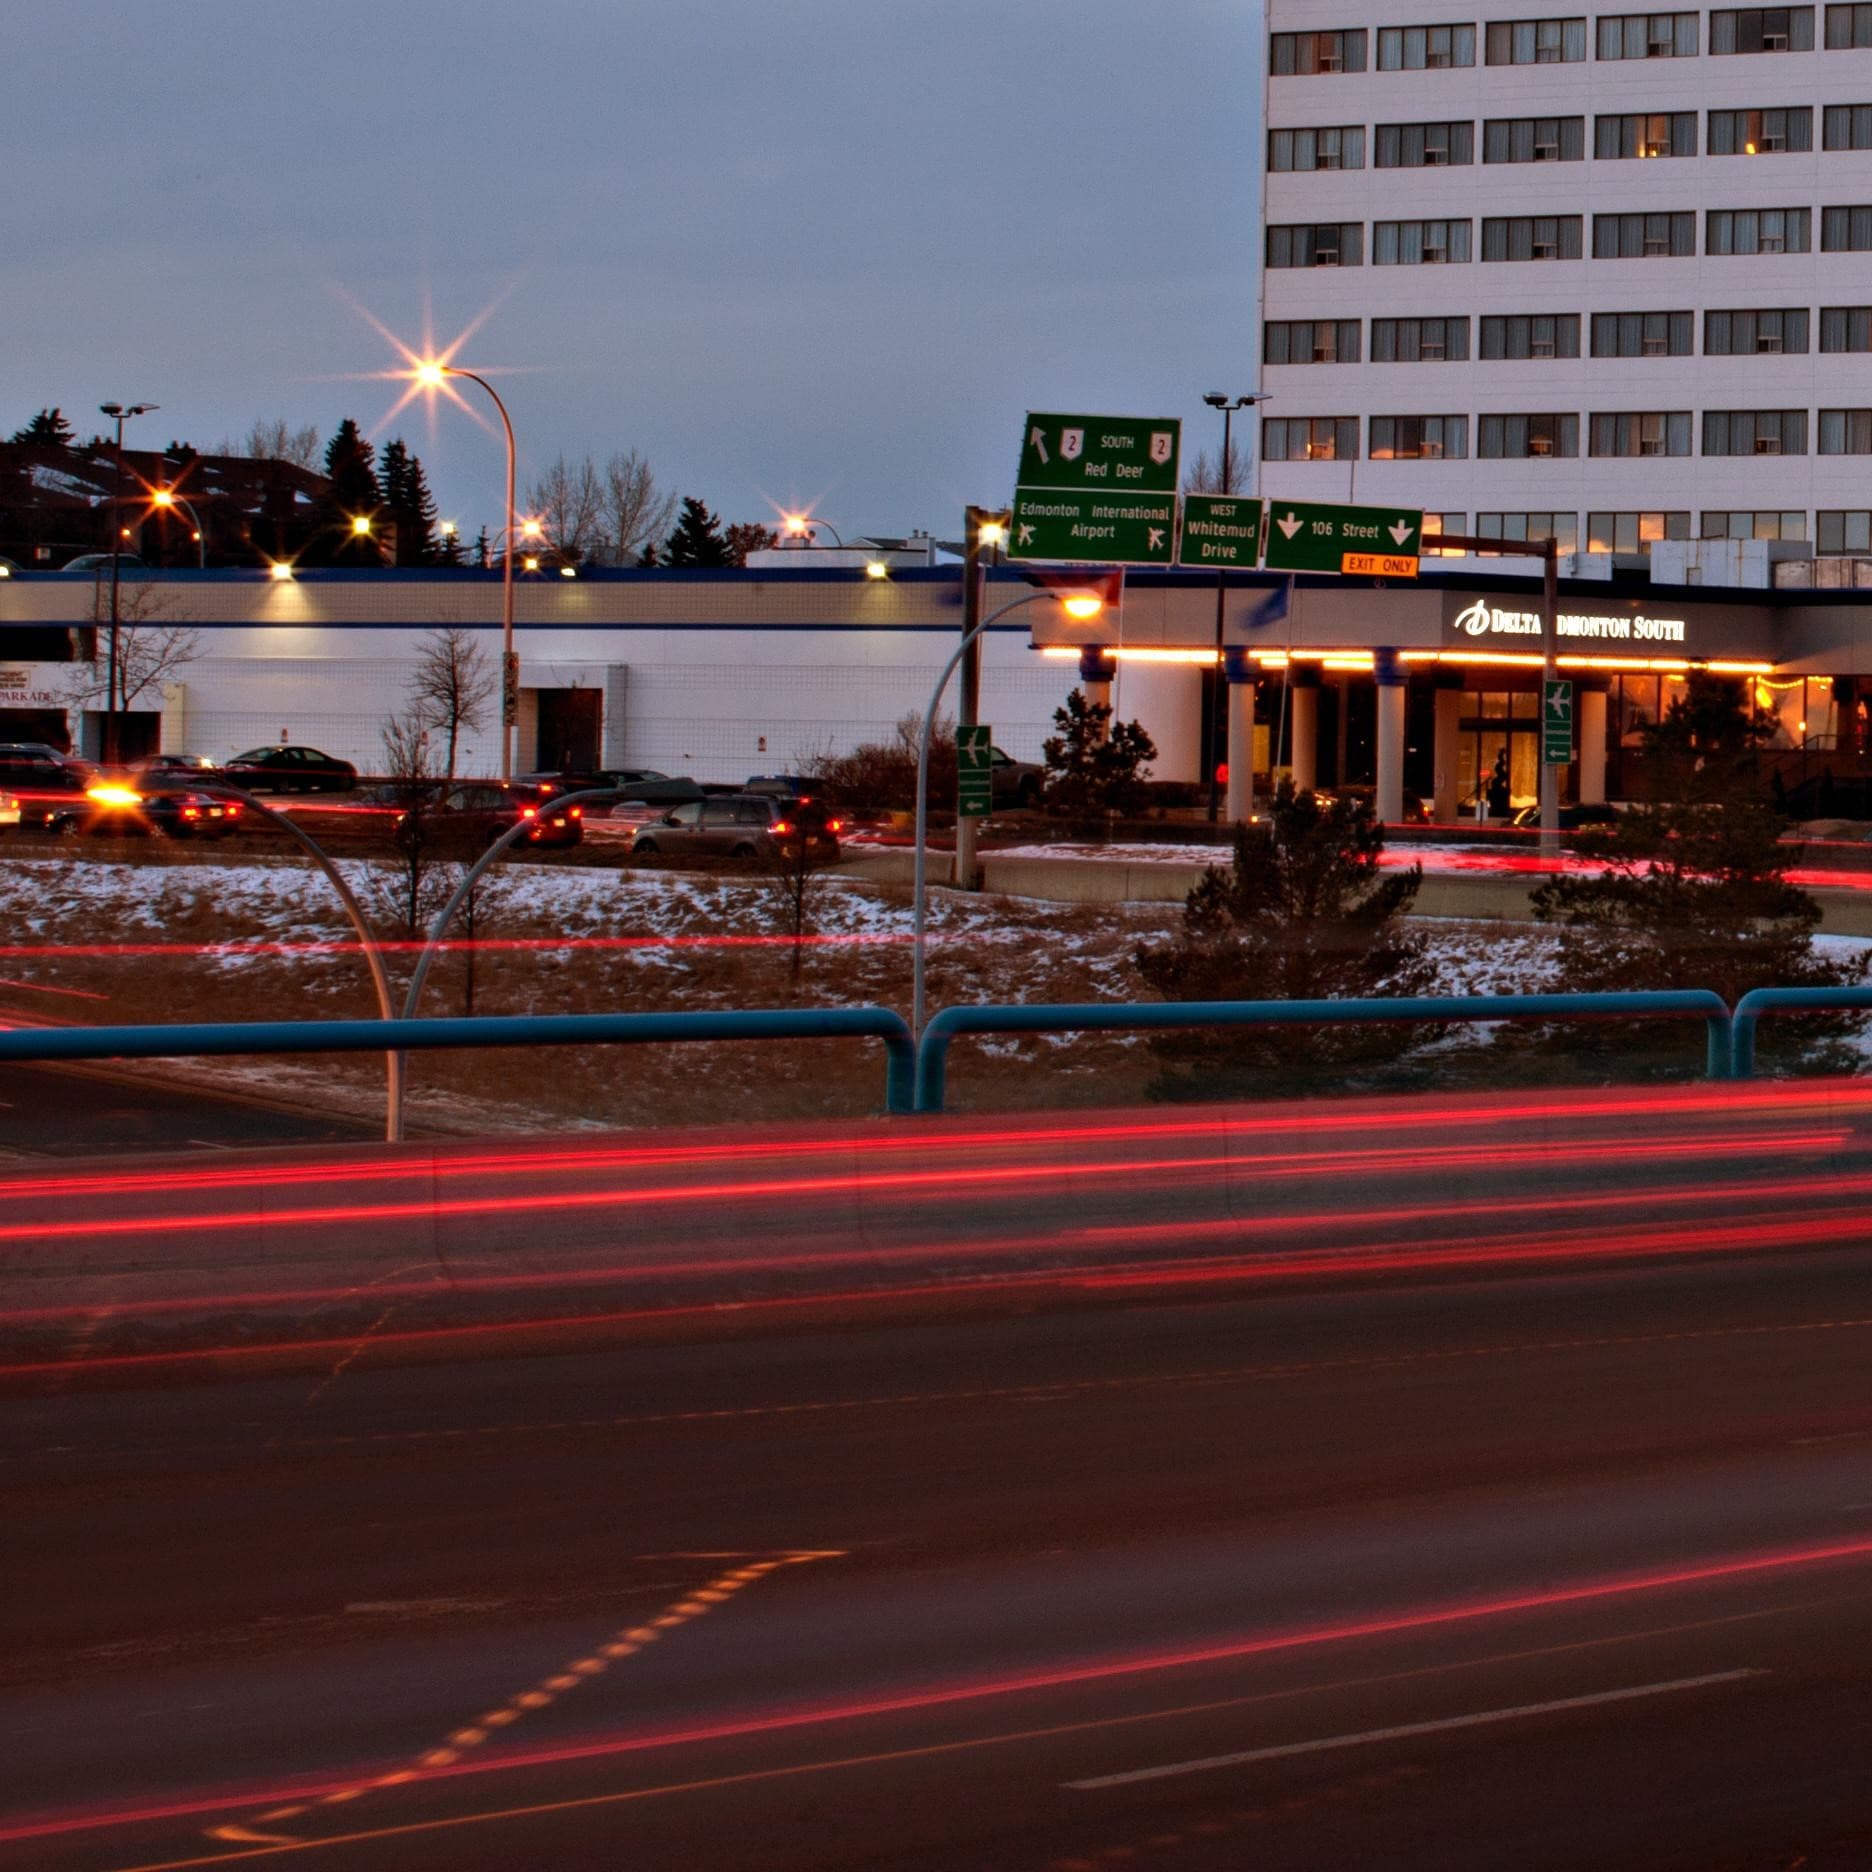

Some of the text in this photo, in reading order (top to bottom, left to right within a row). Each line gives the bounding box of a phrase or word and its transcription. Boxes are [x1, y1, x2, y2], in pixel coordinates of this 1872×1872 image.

[1068, 435, 1077, 451] 2
[1101, 435, 1135, 448] SOUTH
[1157, 439, 1166, 455] 2
[1085, 462, 1144, 478] Red Deer
[1020, 502, 1170, 520] Edmonton International
[1210, 504, 1237, 517] WEST
[1071, 524, 1115, 540] Airport
[1188, 521, 1255, 539] Whitemud
[1311, 521, 1379, 539] 106 Street
[1202, 543, 1238, 559] Drive
[1349, 557, 1413, 573] EXIT ONLY
[1492, 609, 1685, 641] DELTA DMONTON SOUTH
